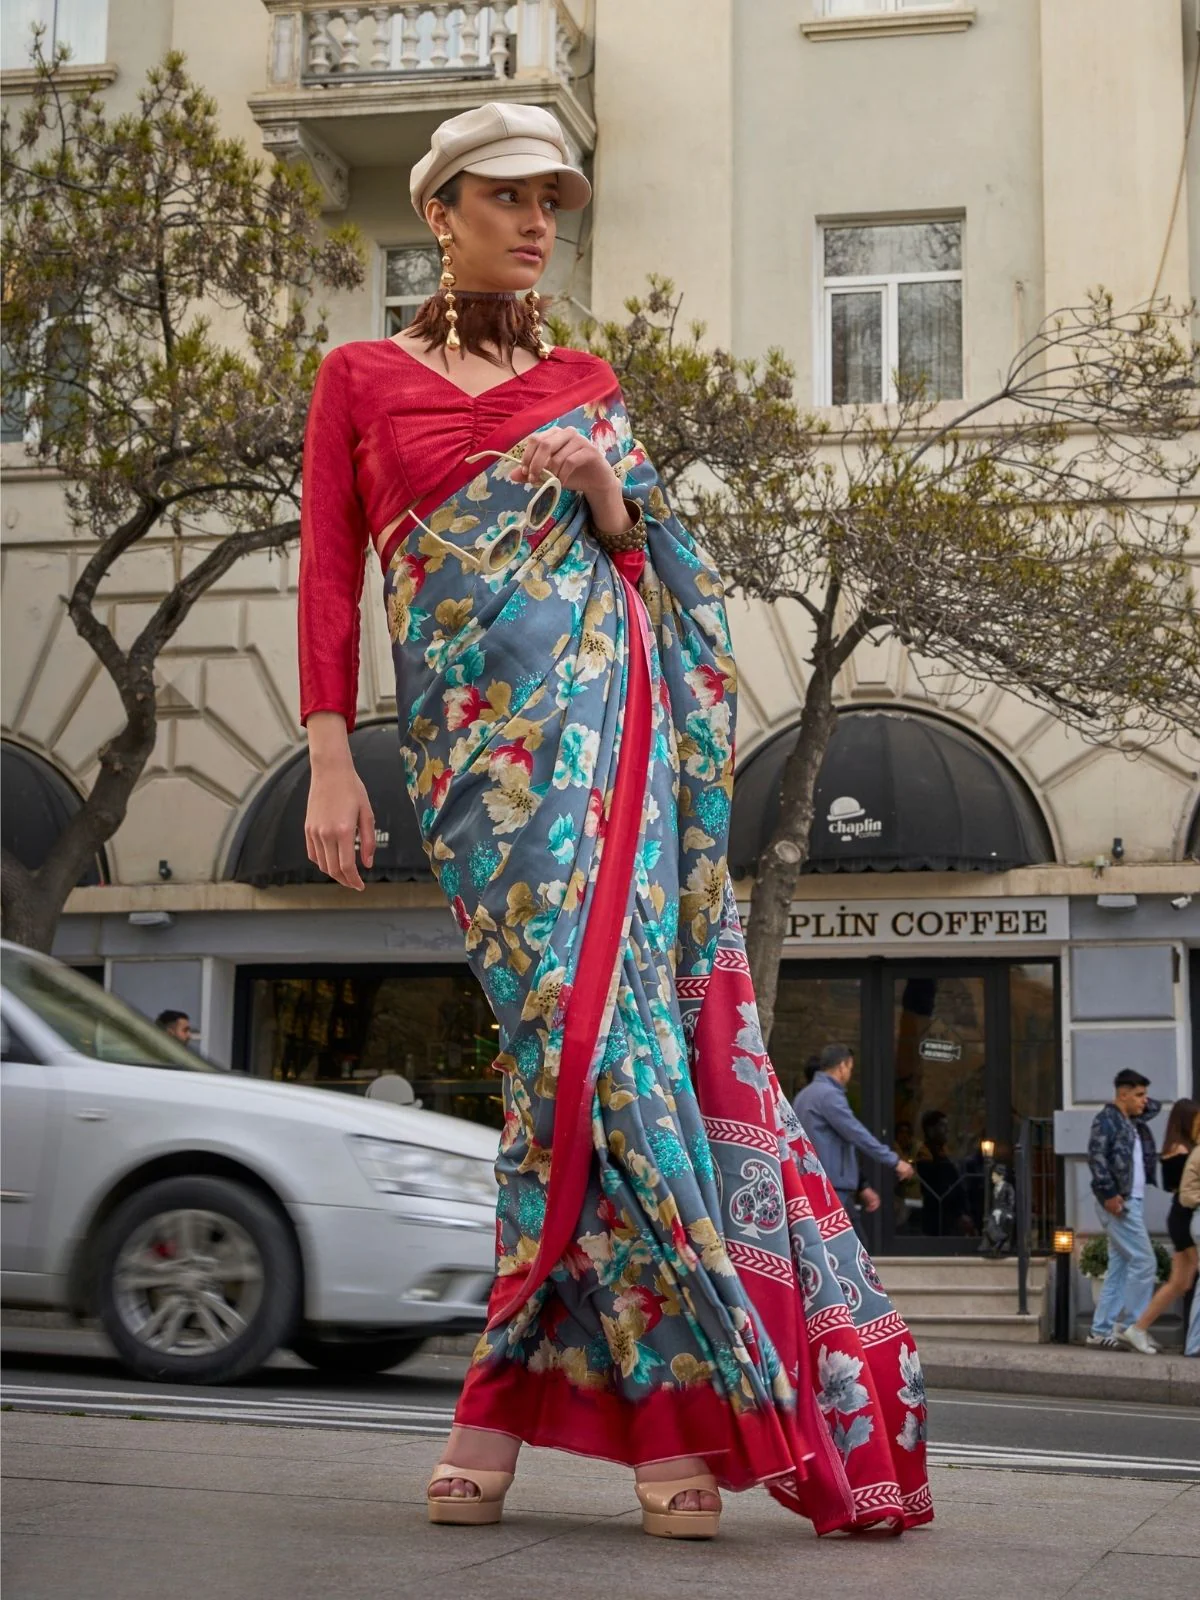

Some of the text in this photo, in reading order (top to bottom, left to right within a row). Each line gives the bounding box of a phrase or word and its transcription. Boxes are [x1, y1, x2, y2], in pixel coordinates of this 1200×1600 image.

[829, 818, 882, 836] chaplin
[740, 905, 1047, 938] PLİN COFFEE
